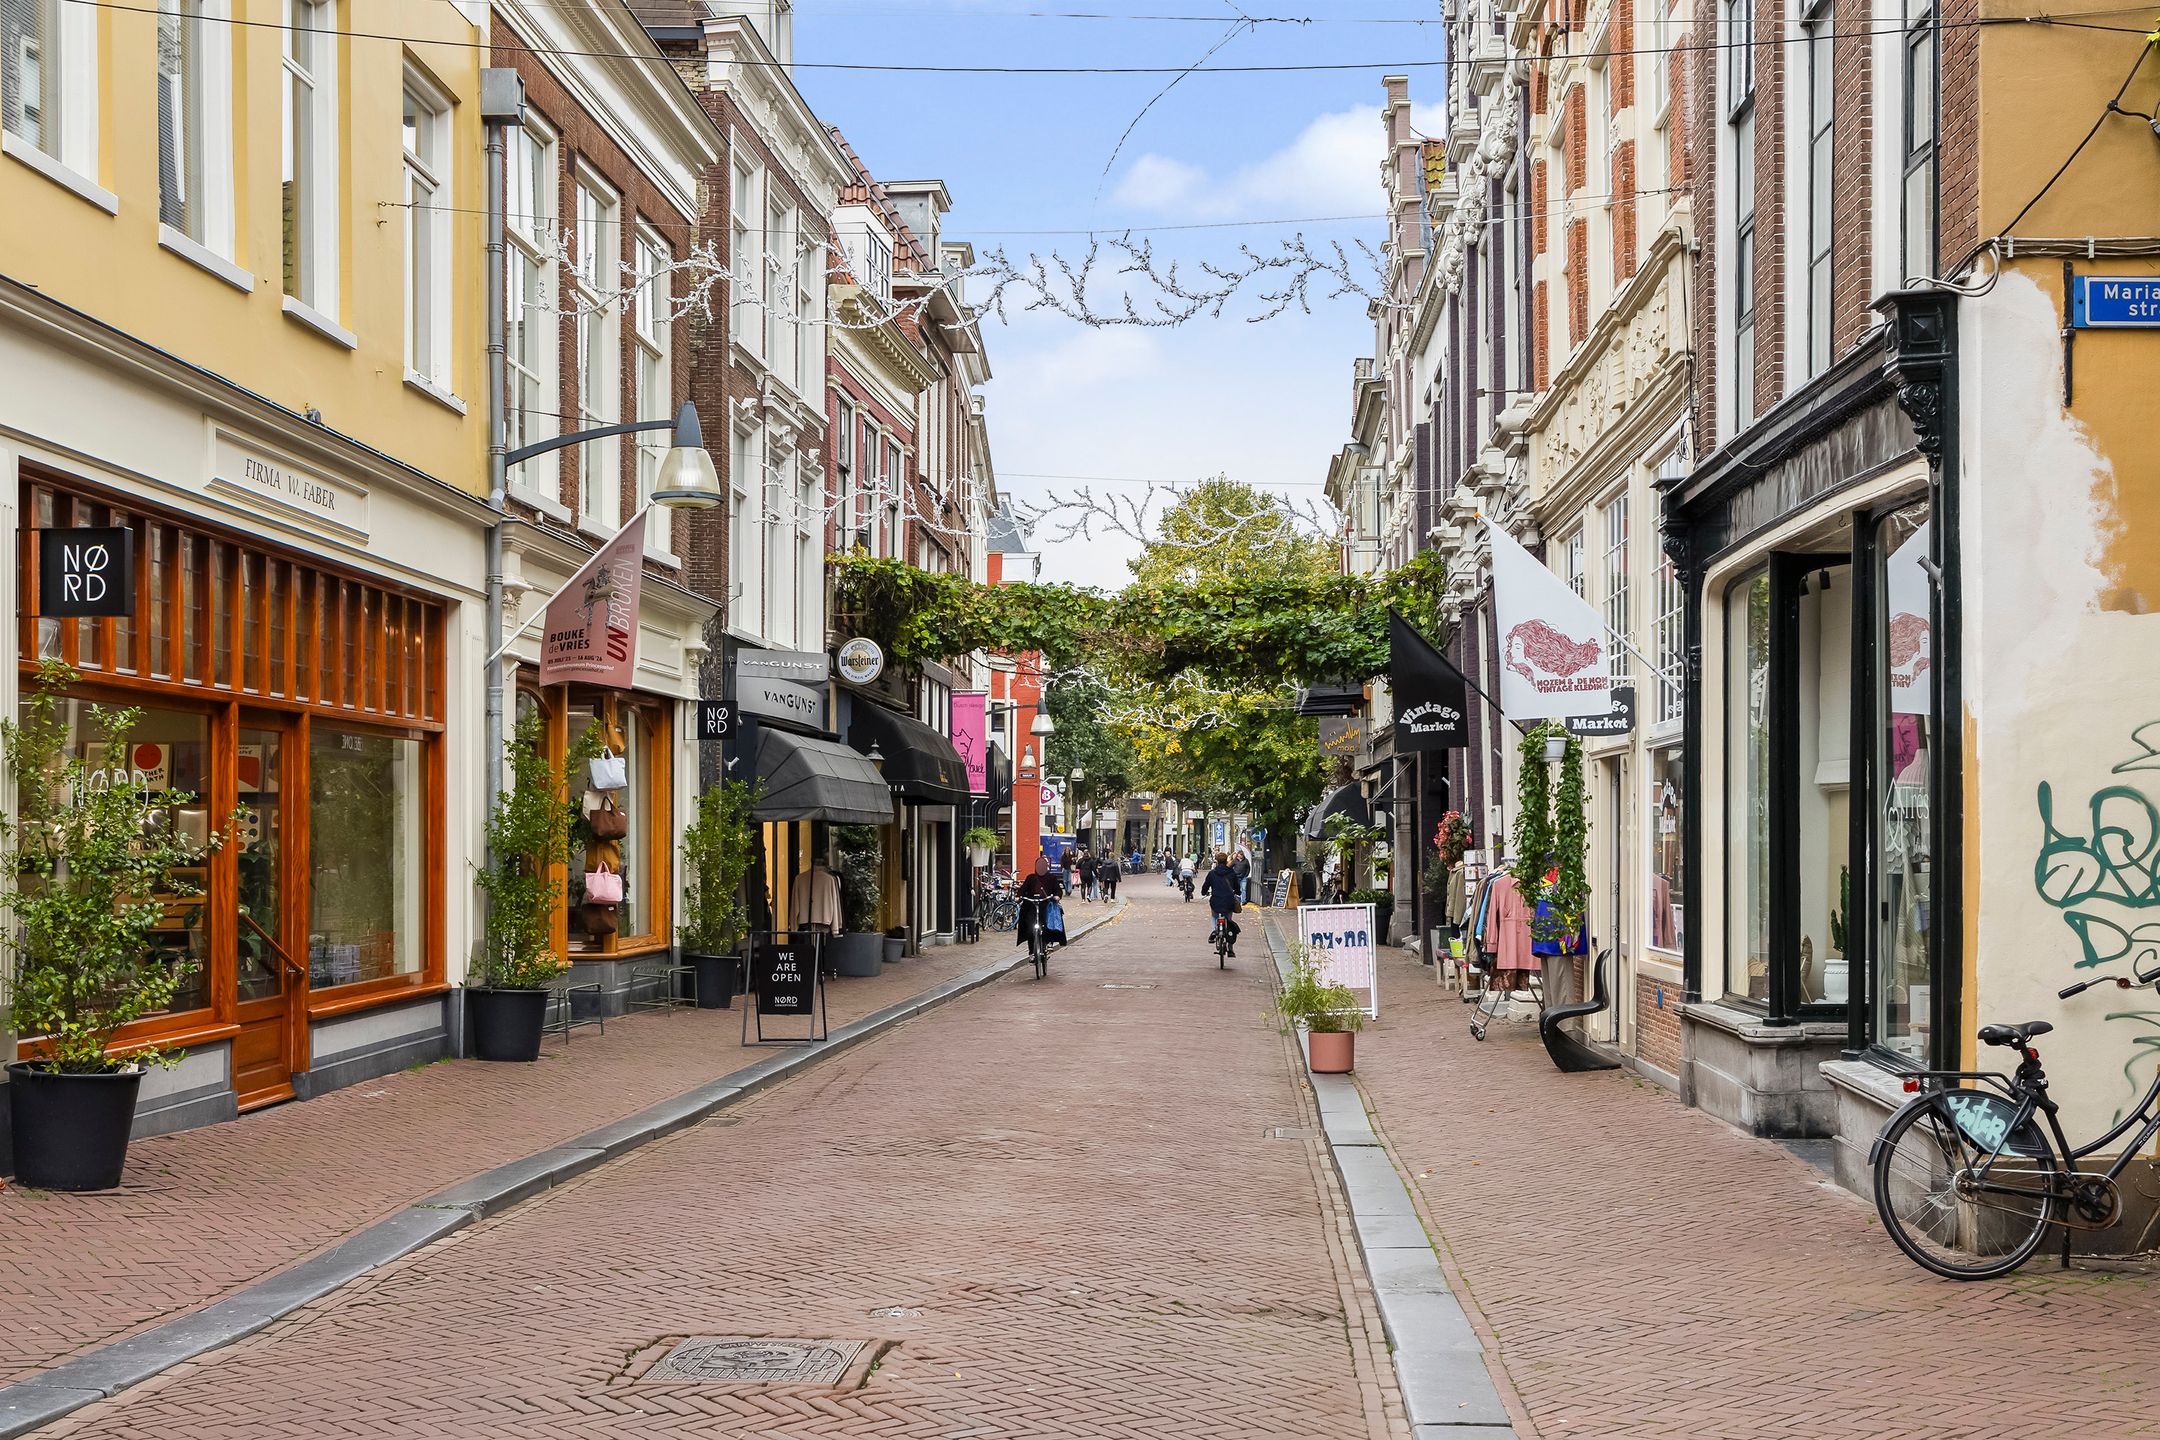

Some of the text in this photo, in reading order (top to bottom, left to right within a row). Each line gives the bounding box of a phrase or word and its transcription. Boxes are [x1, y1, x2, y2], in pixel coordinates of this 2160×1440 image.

[2128, 301, 2160, 316] str
[245, 458, 335, 510] FIRMA W. FABER
[550, 628, 585, 643] BOUKE
[841, 654, 879, 667] Warsteiner
[1536, 679, 1566, 687] NOZEM
[1577, 677, 1588, 685] DE
[1537, 683, 1609, 693] VINTAGE KLEDING
[1399, 701, 1461, 724] Vintage
[1410, 721, 1456, 733] Market
[1572, 717, 1629, 730] Market
[778, 952, 795, 961] WE
[776, 962, 797, 971] ARE
[771, 973, 801, 982] OPEN
[774, 996, 798, 1004] NØRD
